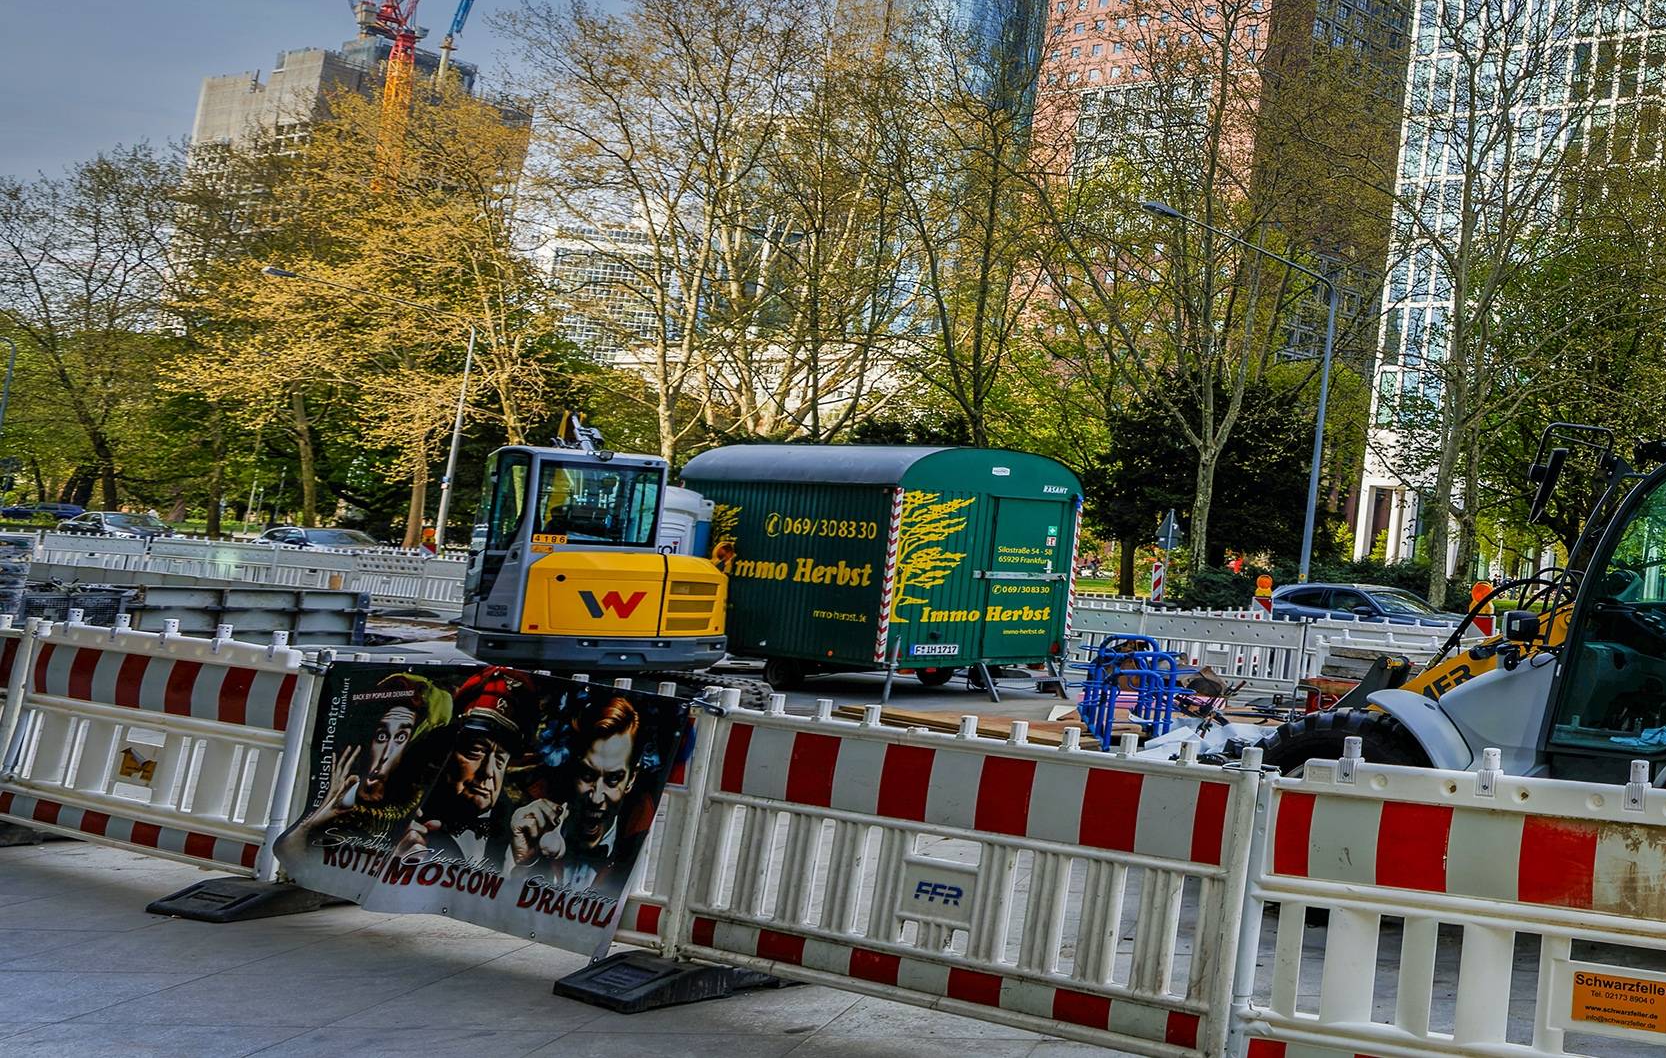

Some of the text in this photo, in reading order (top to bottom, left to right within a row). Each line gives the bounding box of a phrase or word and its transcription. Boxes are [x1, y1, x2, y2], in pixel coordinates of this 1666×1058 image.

[1043, 485, 1068, 494] RASANT
[1020, 556, 1050, 564] Frankfur
[793, 558, 873, 587] Herbst
[919, 606, 1051, 623] Immo Herbst
[338, 677, 351, 718] Frankfurt
[313, 696, 341, 807] English Theatre
[323, 843, 383, 878] ROTTE
[382, 856, 504, 899] MOSCOW
[914, 881, 963, 906] FFR
[1590, 990, 1603, 998] Tel.
[1604, 992, 1628, 1002] 02173
[1629, 996, 1648, 1004] 8904
[1585, 1005, 1658, 1019] www.schwarzfeller.de
[1585, 1015, 1656, 1029] info@schwarzfeller.de
